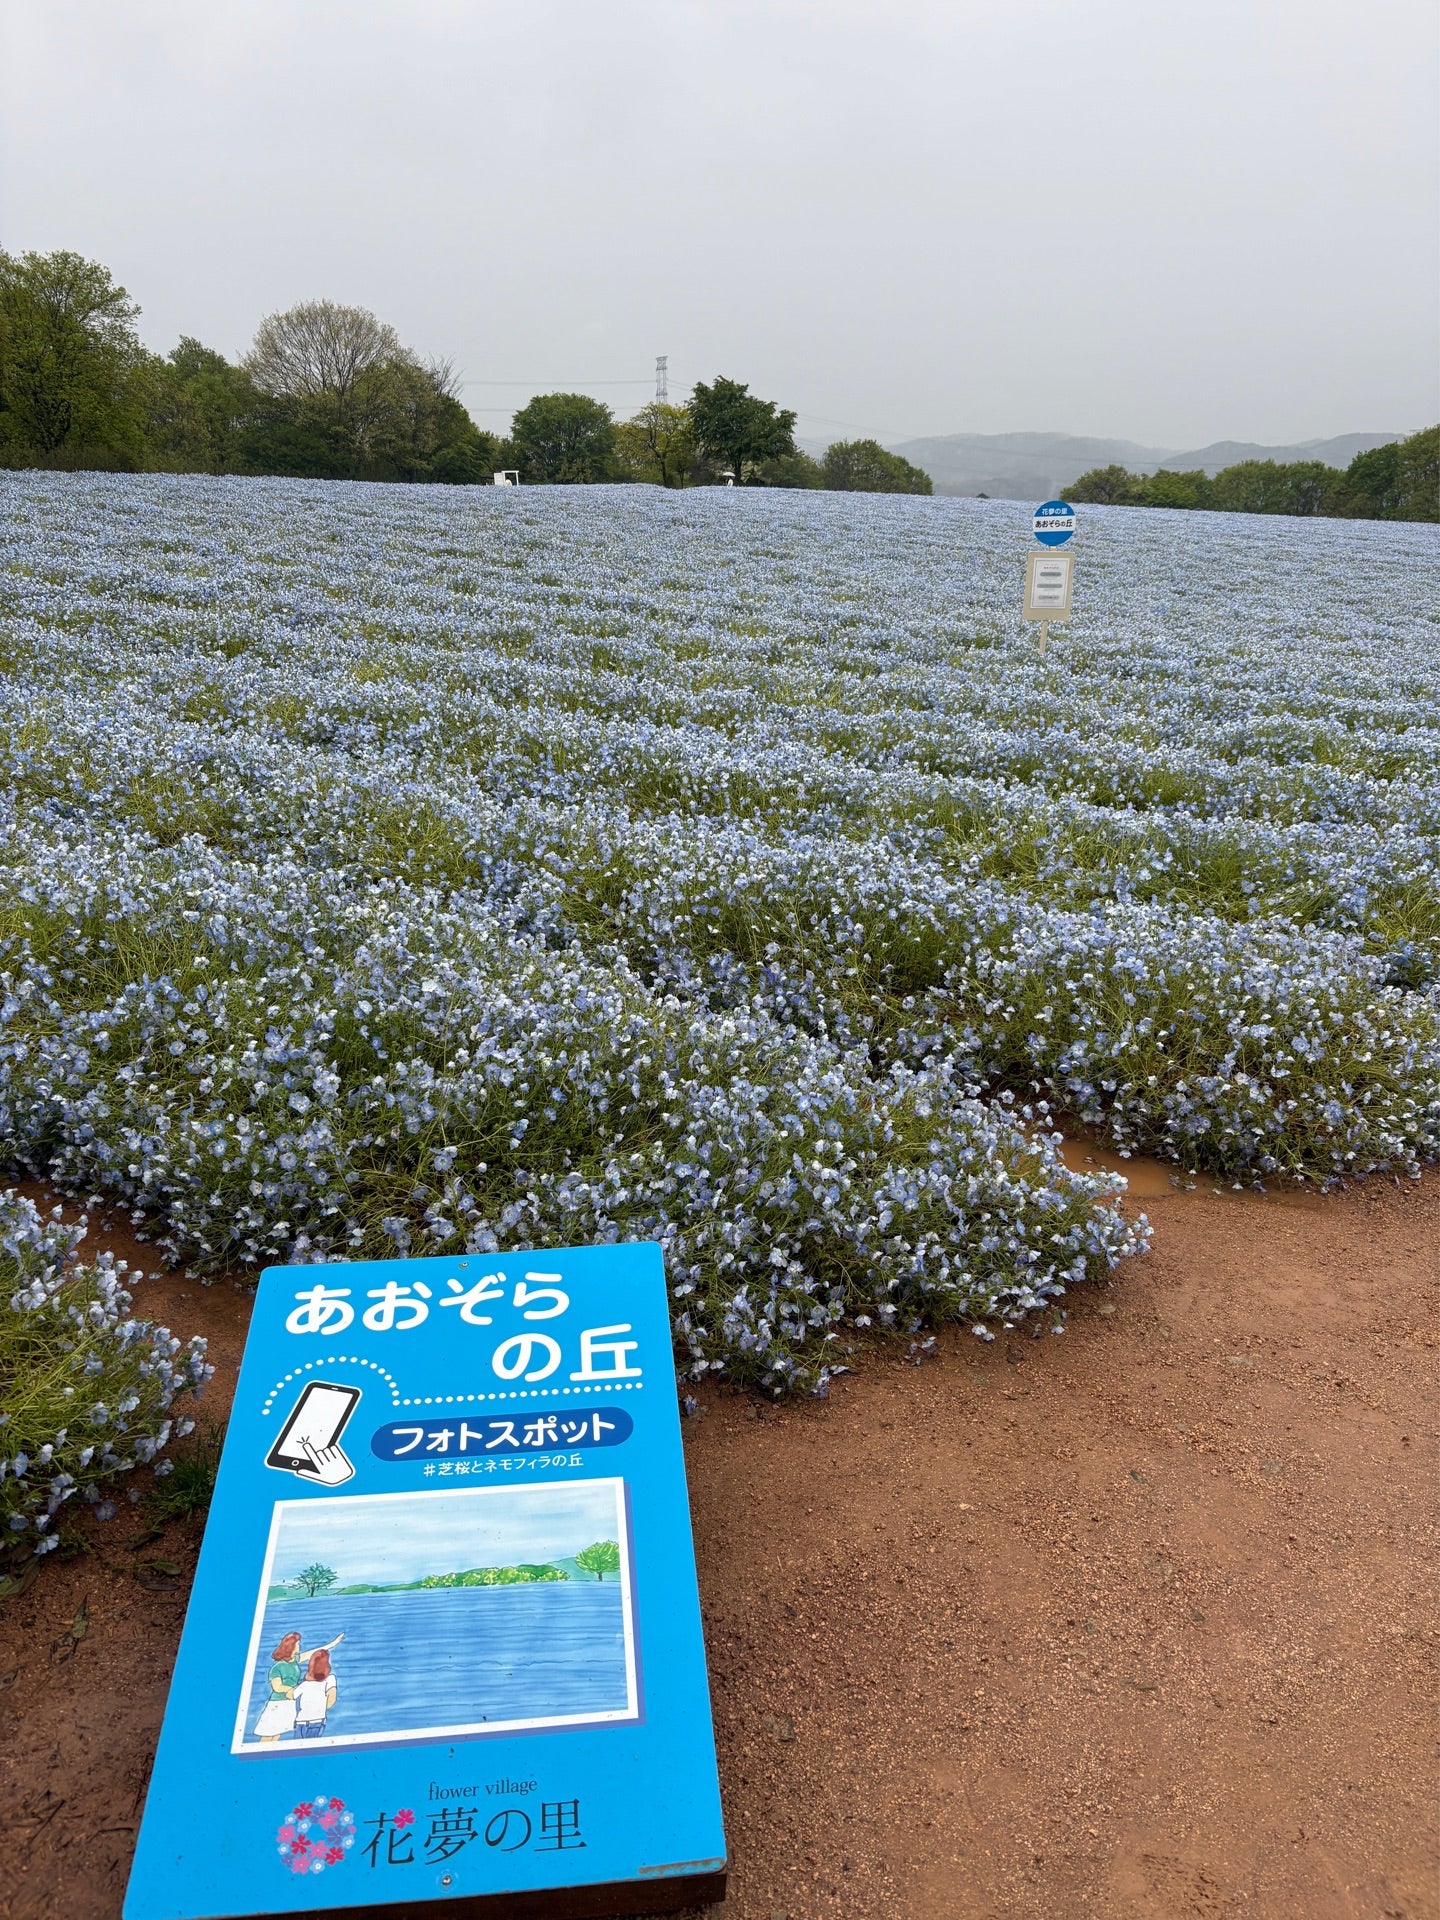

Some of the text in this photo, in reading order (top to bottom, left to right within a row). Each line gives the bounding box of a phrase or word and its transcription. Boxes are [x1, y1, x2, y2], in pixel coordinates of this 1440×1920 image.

[1035, 518, 1073, 528] あおぞらの丘
[1041, 507, 1068, 516] 花夢の里
[285, 1271, 570, 1336] あおぞら
[491, 1323, 643, 1383] の丘
[392, 1412, 616, 1455] フォトスポット
[423, 1453, 585, 1478] #芝桜とネモフィラの丘
[428, 1777, 538, 1801] flower village
[360, 1798, 588, 1869] 花夢の里
